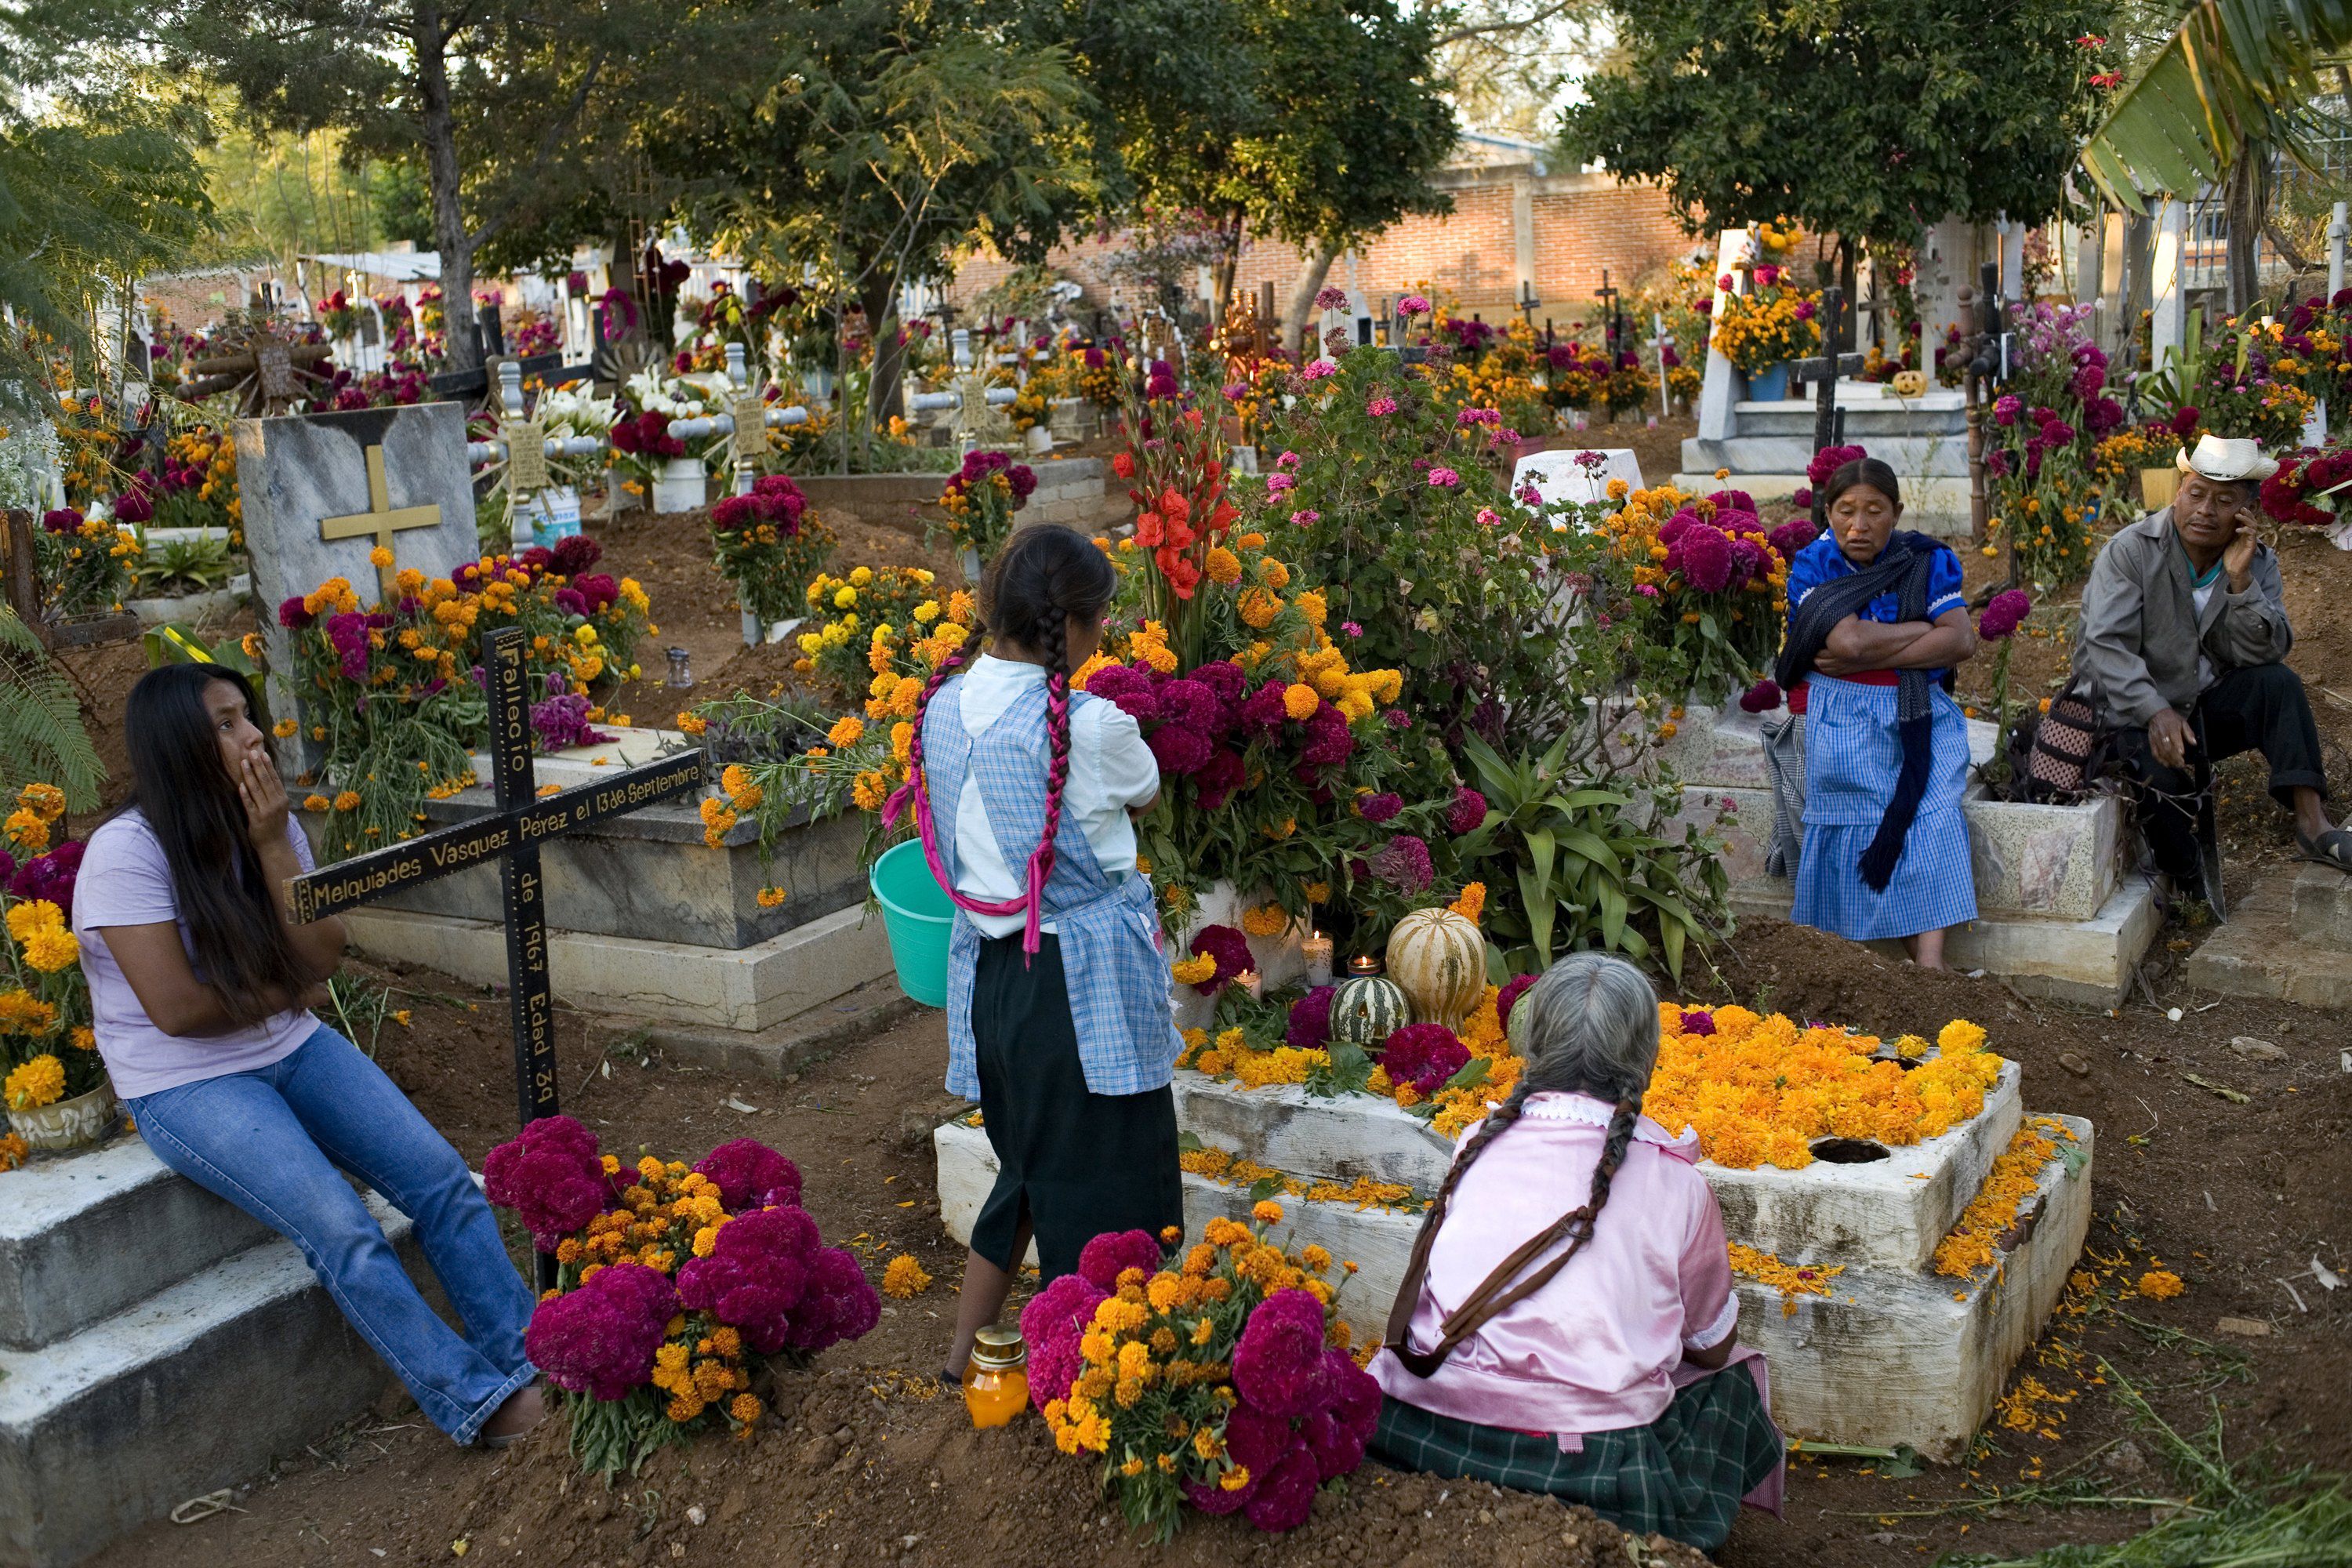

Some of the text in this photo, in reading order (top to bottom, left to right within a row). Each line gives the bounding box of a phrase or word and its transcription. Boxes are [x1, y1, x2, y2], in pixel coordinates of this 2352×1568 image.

[501, 648, 528, 771] Fallecio
[314, 858, 422, 909] Melquiades
[520, 811, 569, 841] Pérez
[575, 798, 590, 821] el
[627, 765, 699, 804] Septiembre
[521, 873, 539, 903] de
[524, 920, 543, 972] 1967
[529, 992, 551, 1057] Edad
